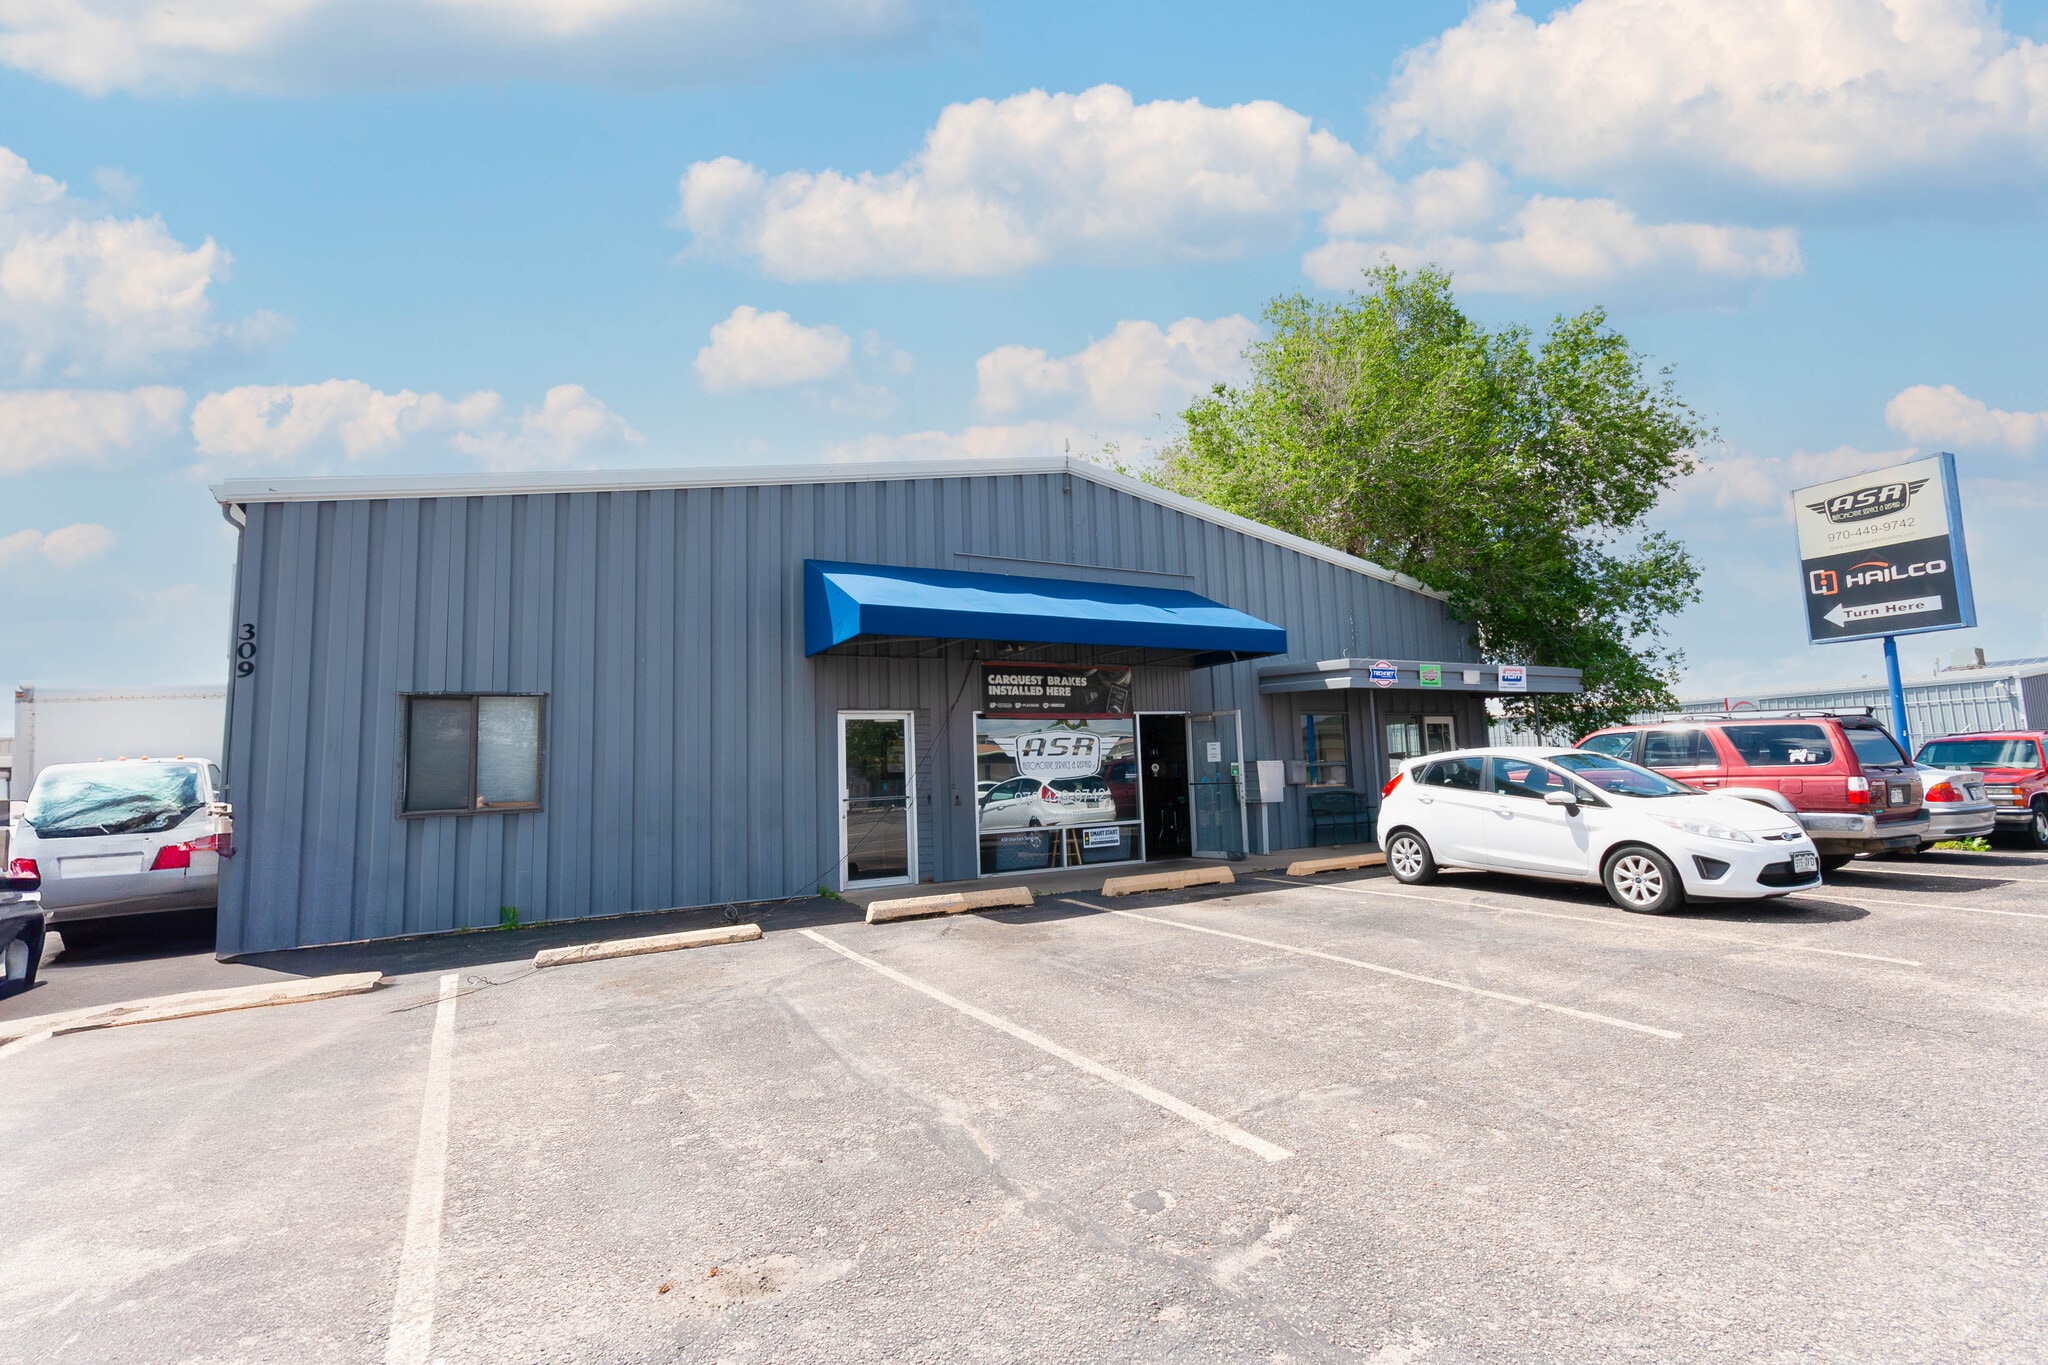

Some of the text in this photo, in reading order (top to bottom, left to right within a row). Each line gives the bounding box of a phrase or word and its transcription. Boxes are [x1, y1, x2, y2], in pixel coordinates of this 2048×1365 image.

[1862, 505, 1879, 515] SERVICE
[1827, 517, 1916, 542] 970-449-9742
[1845, 560, 1947, 588] HAILCO
[1843, 601, 1925, 619] Turn Here
[237, 623, 257, 678] 309
[988, 675, 1087, 686] CARQUEST BRAKES
[988, 685, 1072, 697] INSTALLED HERE
[1022, 737, 1095, 757] ASR
[1022, 760, 1053, 771] AUTOMOTIVE
[1054, 760, 1071, 769] SERVICE
[1077, 760, 1091, 769] REPAIR
